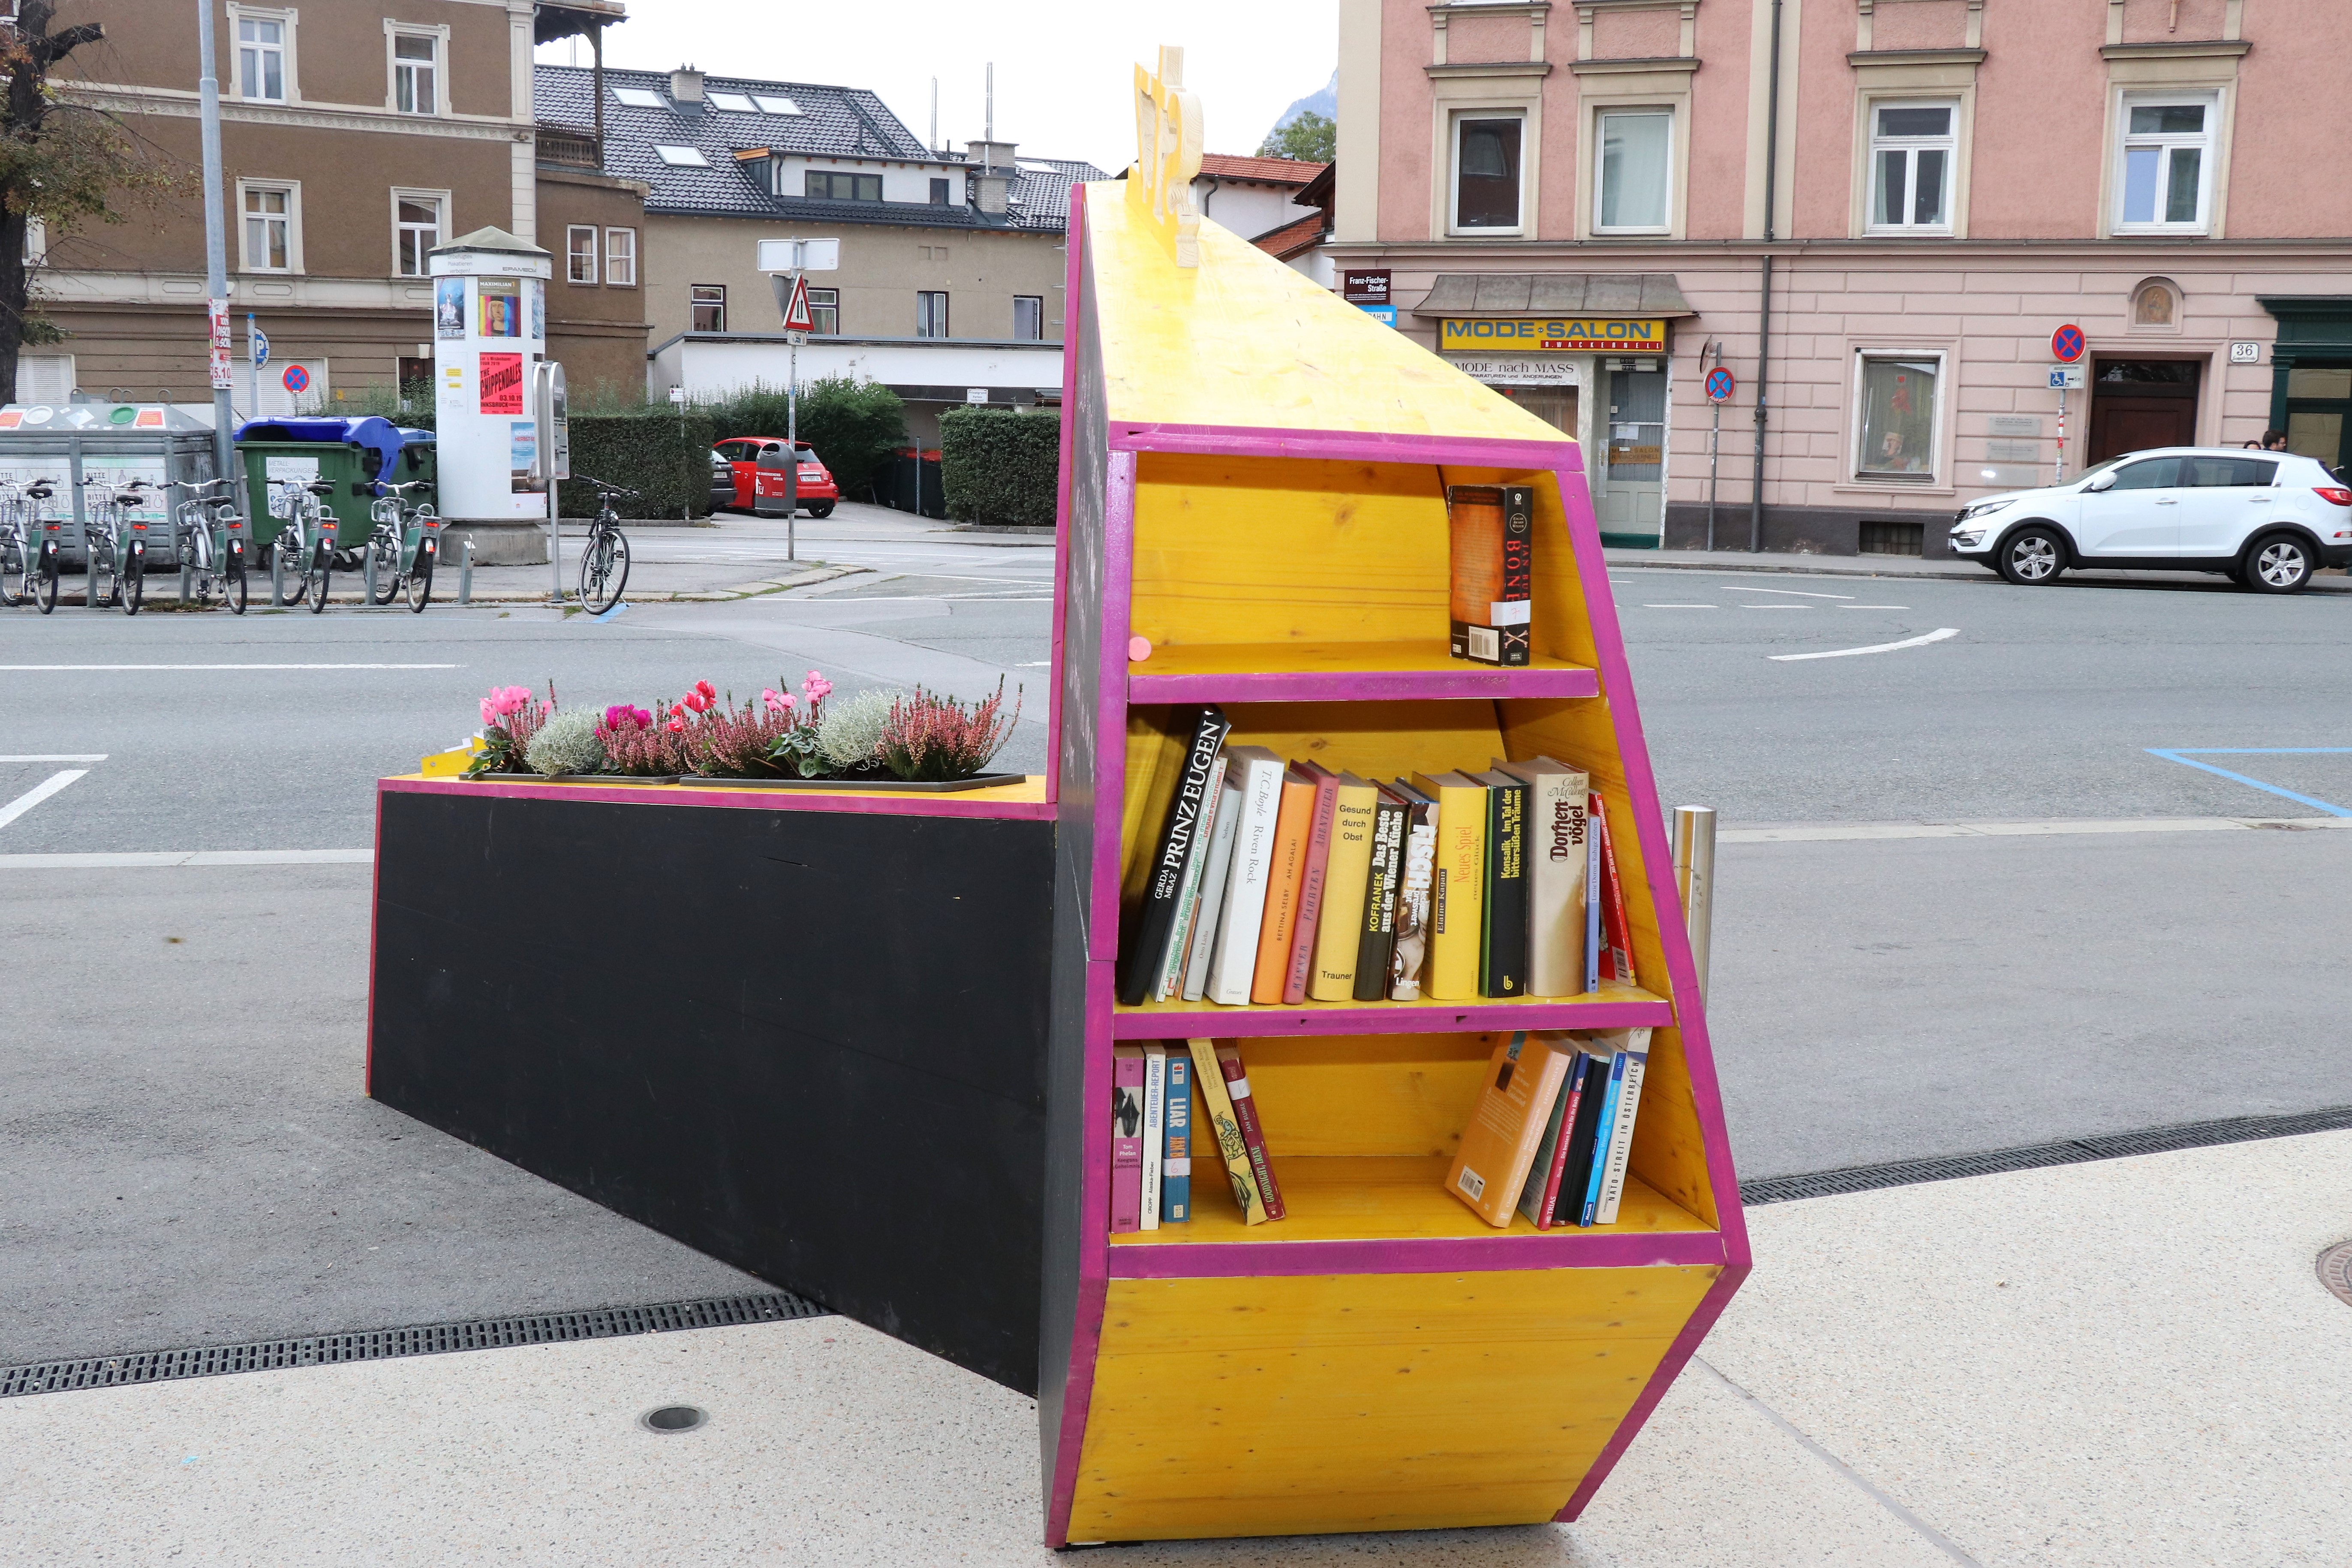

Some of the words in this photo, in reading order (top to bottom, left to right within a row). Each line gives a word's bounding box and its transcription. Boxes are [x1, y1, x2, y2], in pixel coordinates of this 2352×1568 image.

[1349, 276, 1389, 284] Franz-Fischer-
[1447, 322, 1534, 337] MODE
[1546, 323, 1651, 339] SALON
[2237, 344, 2253, 355] 36
[480, 361, 522, 400] CHIPPENDALES
[481, 367, 489, 379] THE
[1499, 363, 1528, 372] nach
[1535, 364, 1573, 373] MASS
[1521, 544, 1529, 566] JAN
[1506, 540, 1522, 602] BONE
[1164, 800, 1198, 869] PRINZ
[1183, 720, 1221, 803] EUGEN
[1563, 776, 1584, 787] Colleen
[1339, 804, 1371, 815] Gesund
[1502, 789, 1512, 804] der
[1512, 789, 1521, 824] Träume
[1314, 788, 1333, 848] ABENTEUER
[1342, 819, 1366, 828] durch
[1501, 820, 1512, 832] Im
[1502, 806, 1512, 819] Tal
[1568, 805, 1587, 846] vögel
[1251, 825, 1263, 854] Riven
[1343, 833, 1363, 841] Obst
[1375, 810, 1390, 845] Beste
[1388, 811, 1403, 848] Küche
[1288, 839, 1297, 868] AGALAI
[1372, 846, 1386, 867] Das
[1501, 839, 1511, 879] Konsalik
[1510, 824, 1521, 878] bittersüßen
[1164, 940, 1179, 982] Langenscheidt
[1180, 887, 1191, 918] Mondadori
[1191, 850, 1199, 870] Lingua
[1205, 775, 1217, 808] Arbeitsbuch
[1246, 859, 1259, 884] Rock
[1287, 869, 1293, 879] AH
[1383, 850, 1399, 891] Wiener
[1454, 851, 1471, 883] Neues
[1155, 869, 1170, 899] GERDA
[1164, 873, 1178, 899] MRAZ
[1438, 870, 1447, 900] Kagan
[1281, 889, 1290, 912] SELBY
[1368, 872, 1384, 932] KOFRANEK
[1383, 891, 1394, 911] der
[1410, 890, 1420, 926] preiswert
[1277, 912, 1285, 941] BETTINA
[1381, 912, 1390, 933] aus
[1437, 902, 1447, 932] Elaine
[1322, 971, 1352, 979] Trauner
[1396, 976, 1420, 989] Lingen
[1149, 1060, 1160, 1129] ABENTEUER-REPORT
[1622, 1061, 1639, 1119] ÖSTERREICH
[1169, 1098, 1186, 1128] LIAR
[1244, 1122, 1253, 1132] JAN
[1621, 1125, 1628, 1134] IN
[1251, 1146, 1262, 1165] IRENE
[1595, 1147, 1605, 1168] Bettina
[1600, 1129, 1609, 1147] Wenzel
[1256, 1165, 1274, 1203] GOODNIGHT,
[1547, 1195, 1556, 1216] TRIAS
[1562, 1134, 1571, 1150] besten
